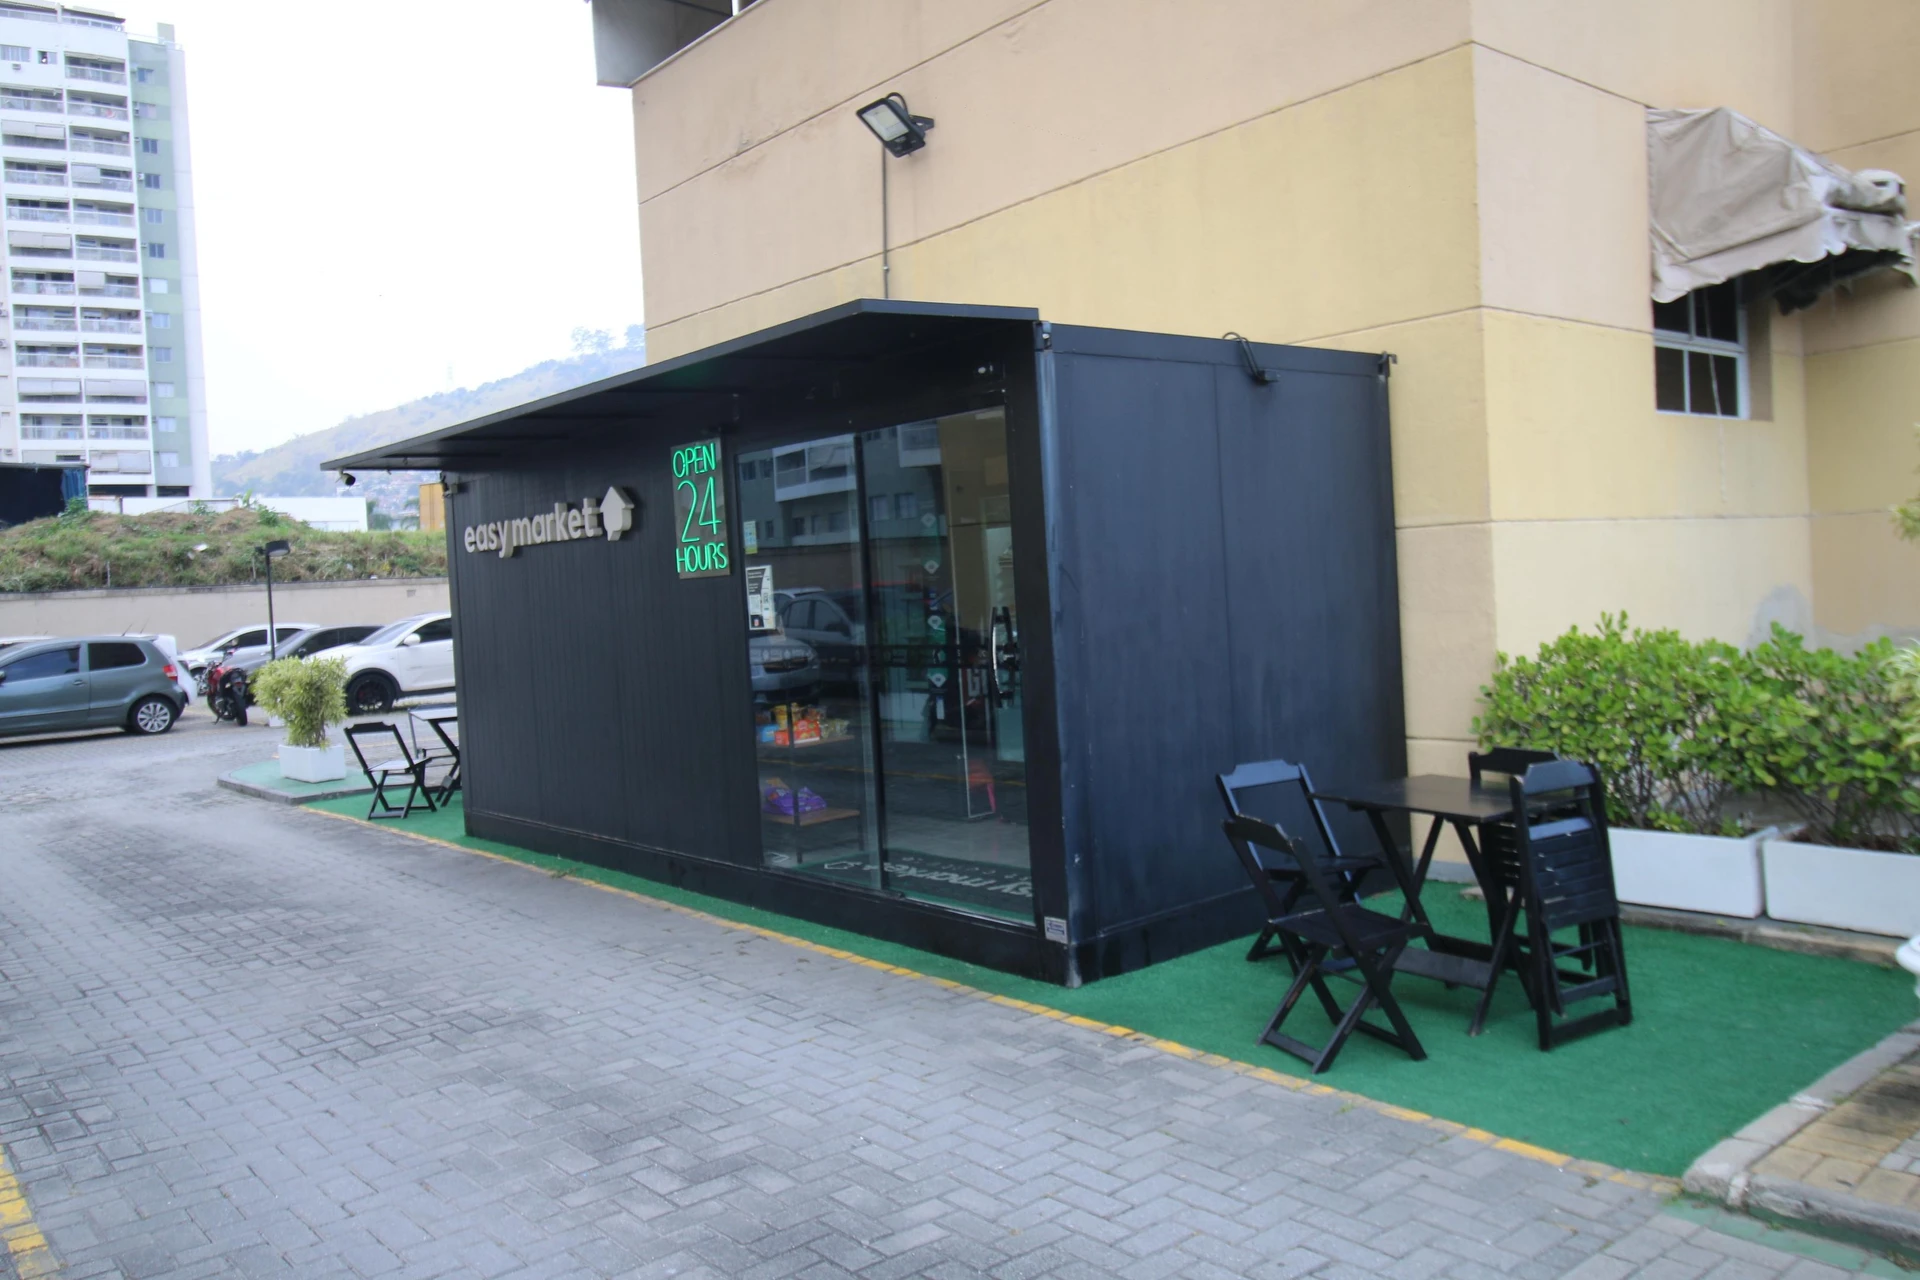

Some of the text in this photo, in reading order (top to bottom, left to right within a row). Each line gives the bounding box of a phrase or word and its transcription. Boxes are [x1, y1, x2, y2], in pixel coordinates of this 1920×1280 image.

[672, 442, 716, 478] OPEN
[464, 497, 602, 558] easymarket
[676, 476, 722, 543] 24
[675, 542, 728, 574] HOURS
